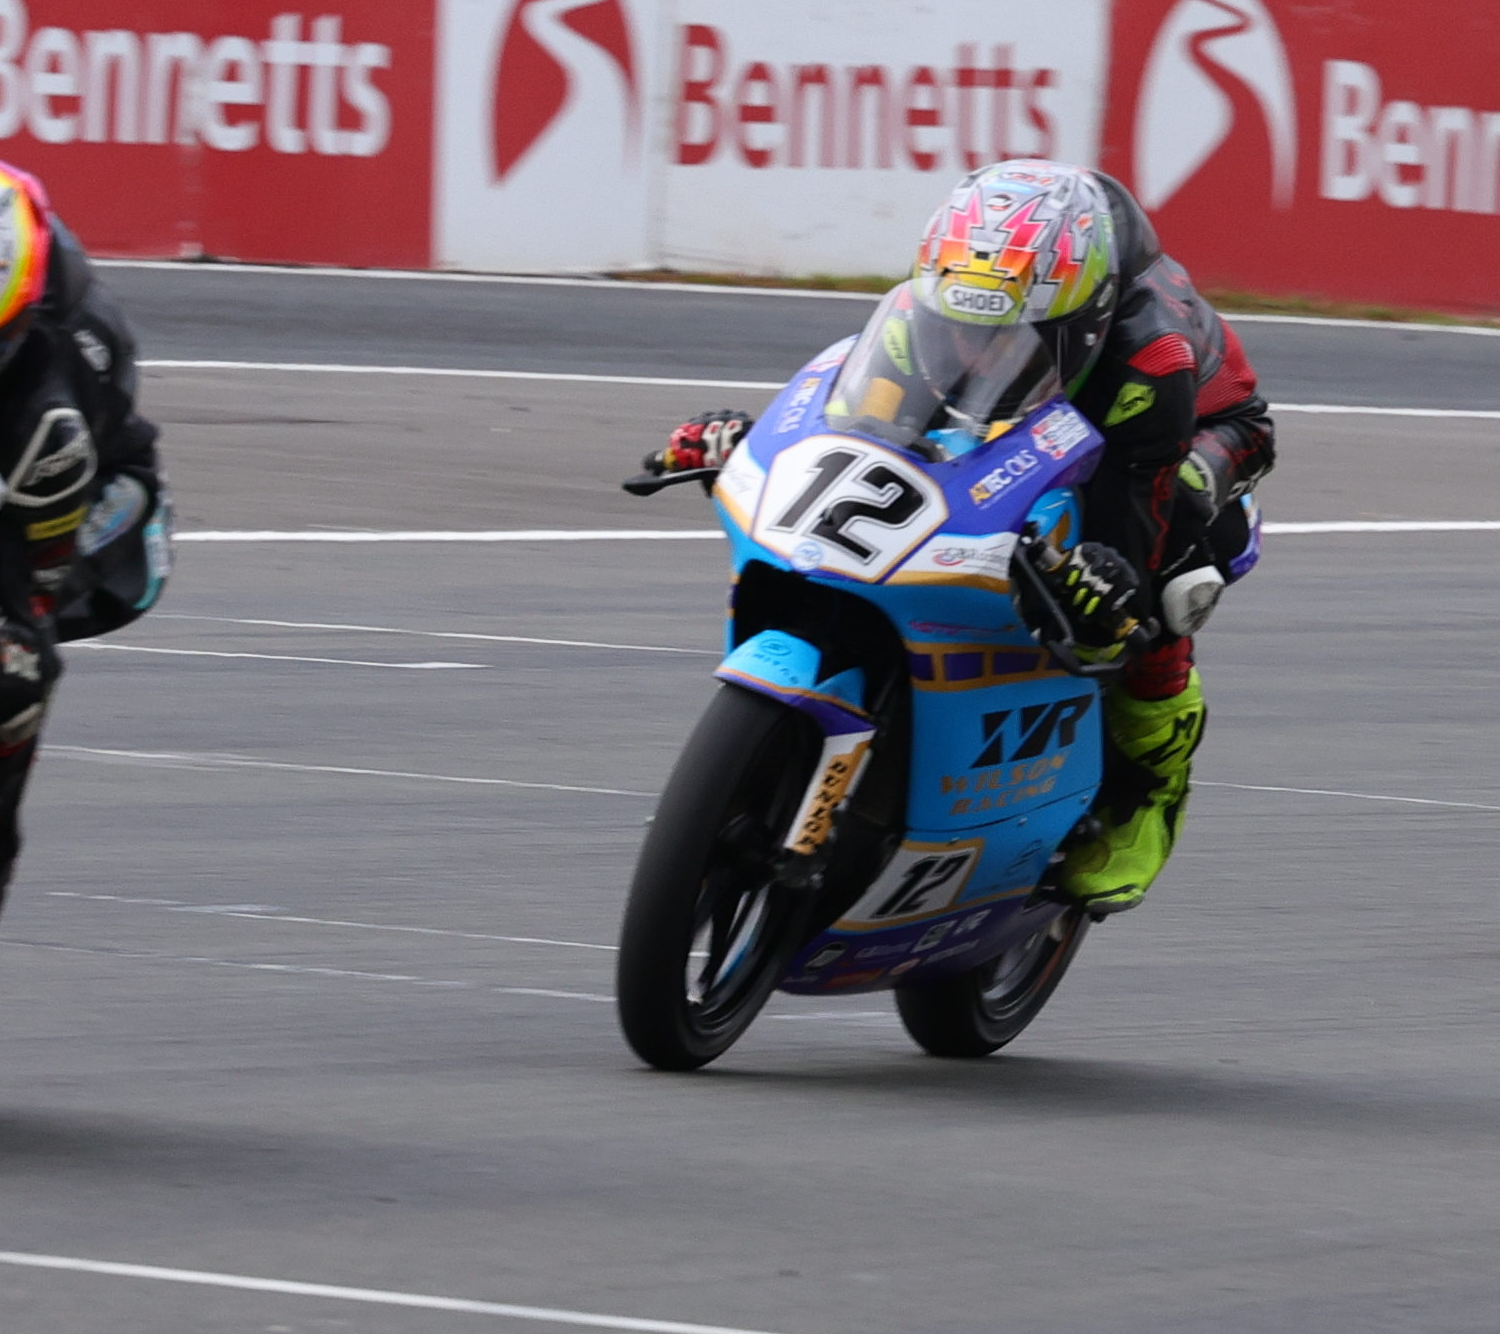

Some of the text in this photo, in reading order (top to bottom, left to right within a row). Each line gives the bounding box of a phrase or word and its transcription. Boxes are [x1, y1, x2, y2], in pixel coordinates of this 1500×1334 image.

[673, 23, 1059, 173] Bennetts
[952, 288, 1007, 313] SHOEI
[768, 449, 927, 565] 12
[939, 753, 1068, 795] WILSON
[948, 774, 1057, 816] RACING
[868, 852, 974, 918] 12
